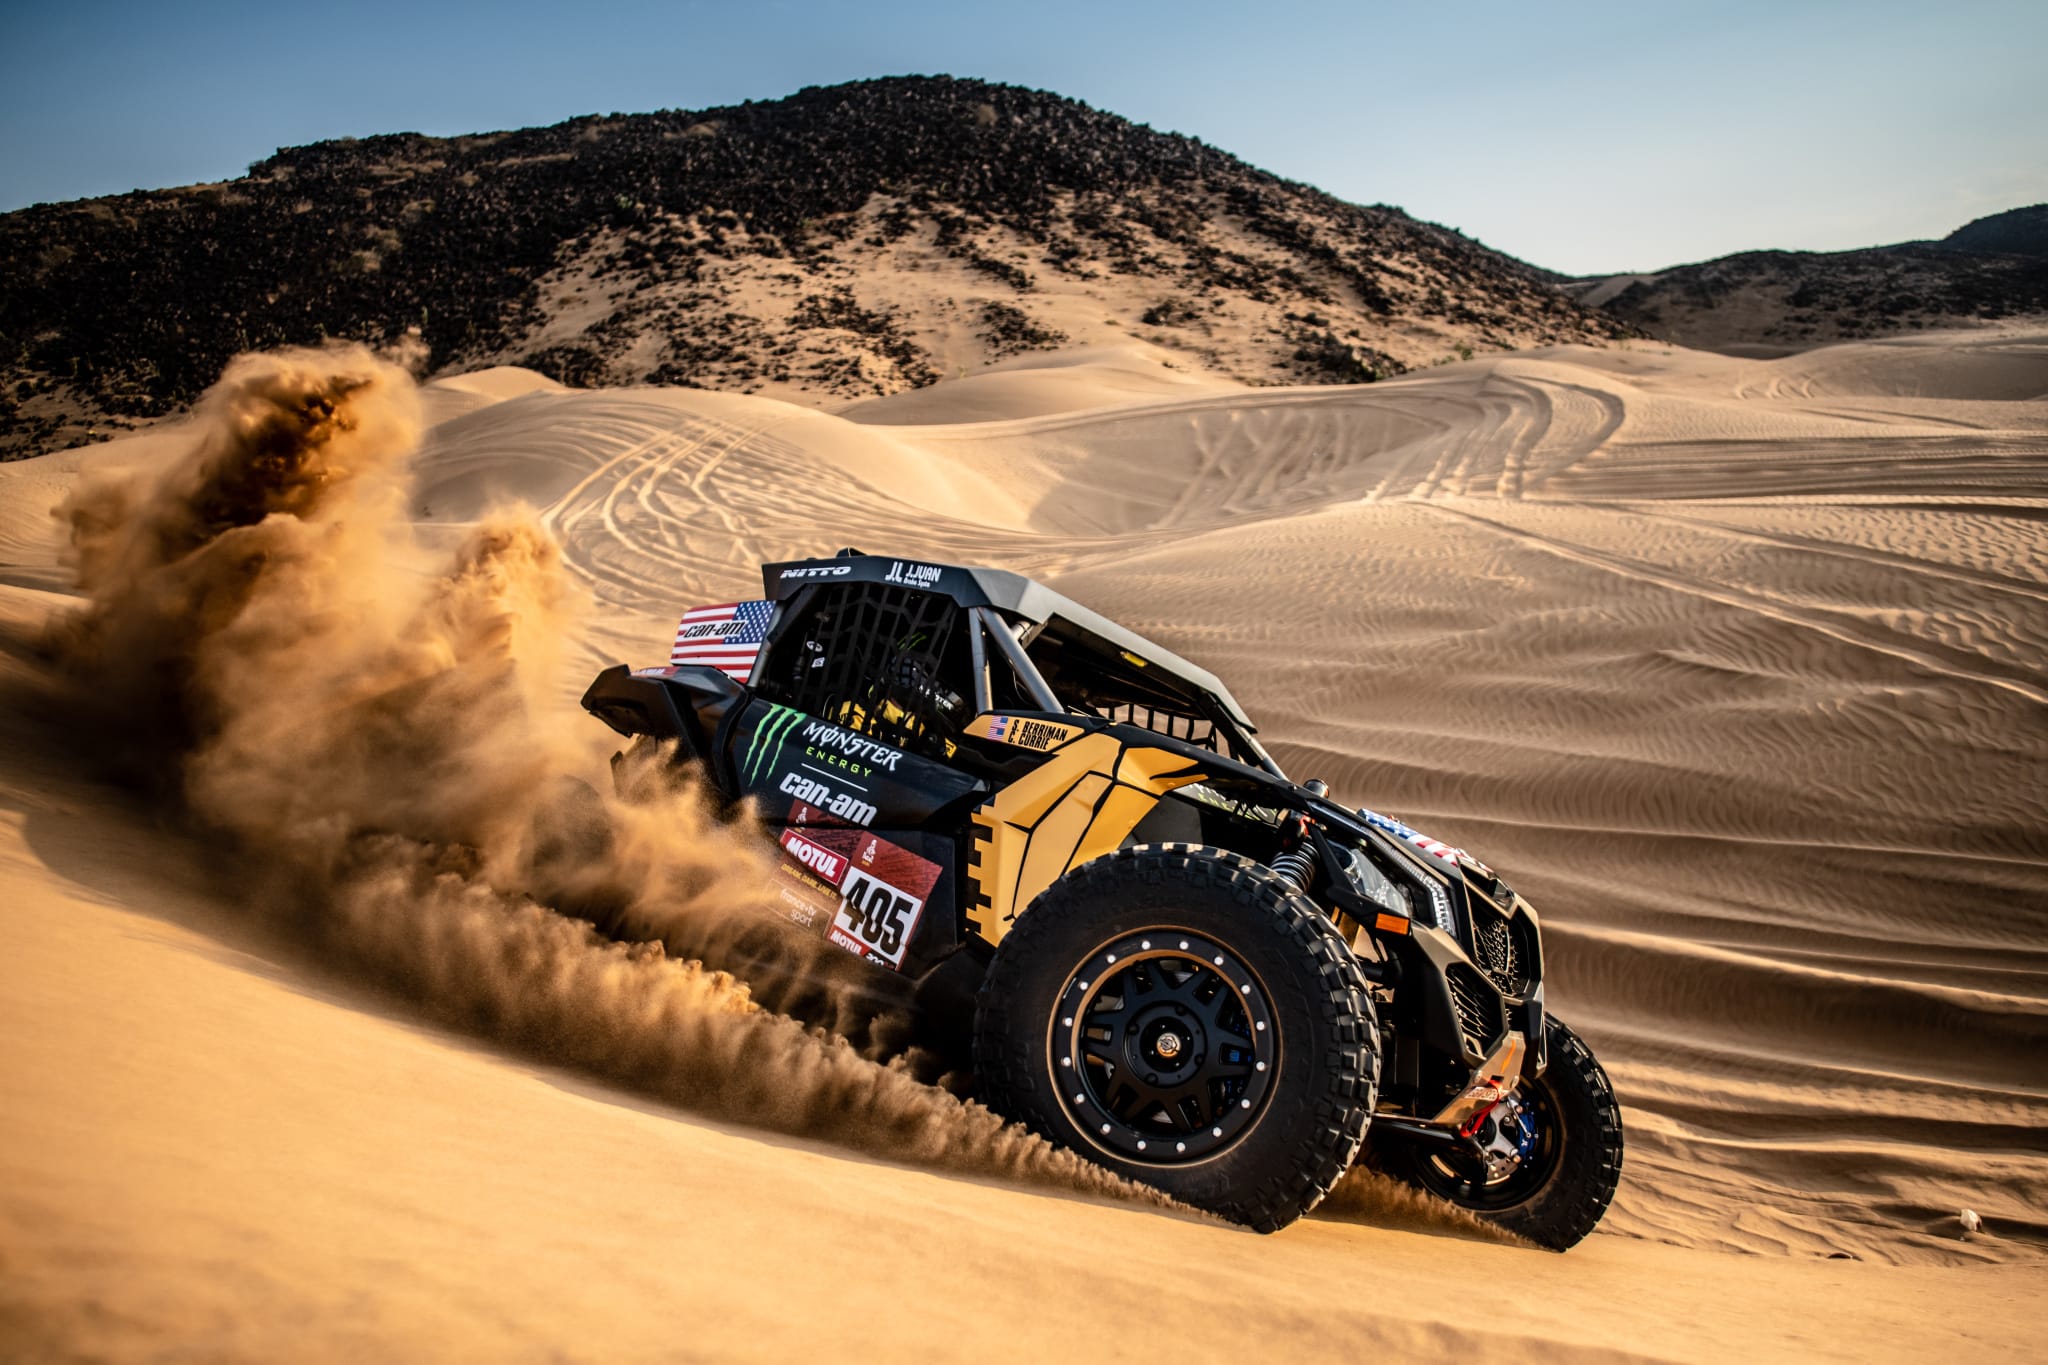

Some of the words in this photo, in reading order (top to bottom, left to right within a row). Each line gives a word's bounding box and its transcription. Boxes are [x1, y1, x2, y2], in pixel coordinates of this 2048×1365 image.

[780, 566, 852, 579] NITTO
[905, 564, 942, 583] J.JUAN
[683, 621, 747, 638] can-am
[1008, 730, 1016, 744] C.
[1018, 733, 1051, 751] CURRIE
[1011, 719, 1020, 732] S.
[1022, 721, 1068, 742] BERRIMAN
[806, 746, 873, 777] ENERGY
[779, 772, 877, 827] can-am
[786, 837, 838, 877] MOTUL
[791, 909, 813, 928] sport
[843, 877, 915, 955] 405
